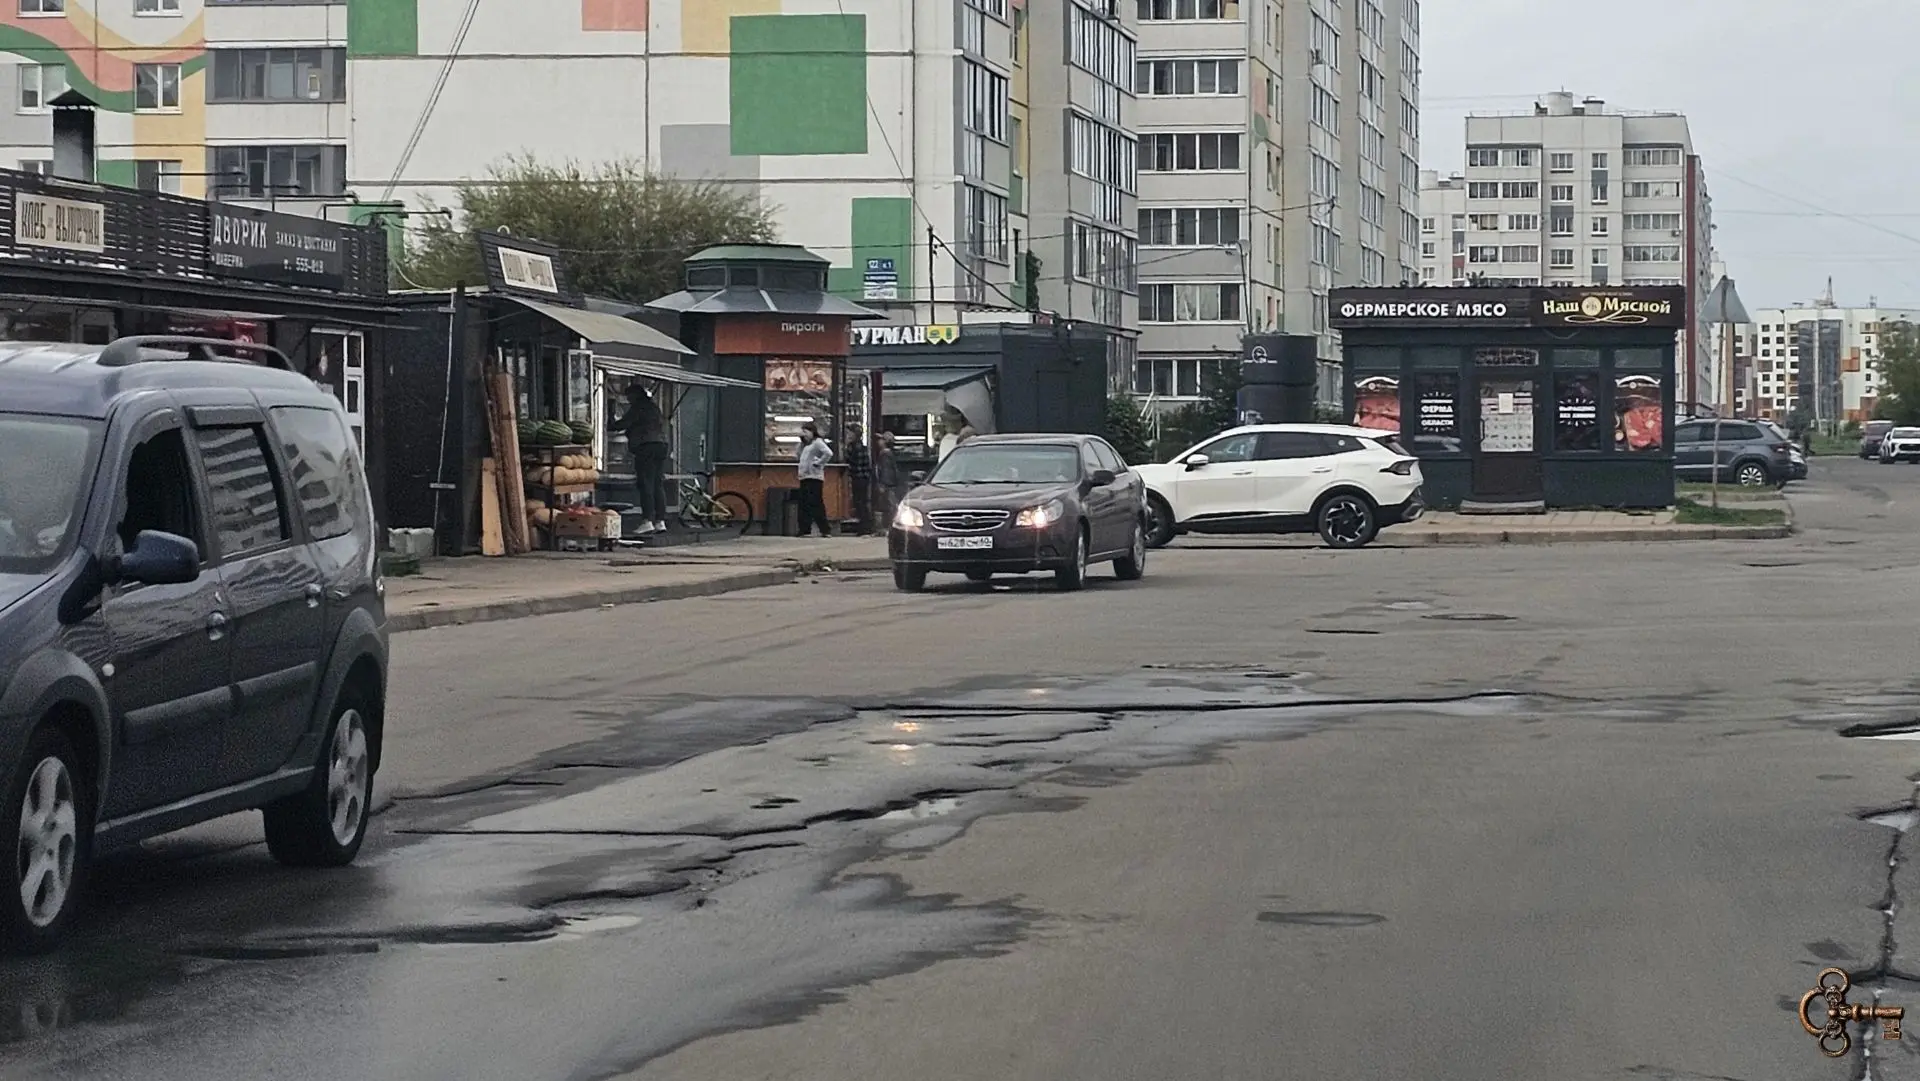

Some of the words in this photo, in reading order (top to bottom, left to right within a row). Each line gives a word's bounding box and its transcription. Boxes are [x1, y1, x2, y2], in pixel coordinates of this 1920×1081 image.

[213, 214, 267, 249] ДВОРИК
[1340, 303, 1449, 317] ФЕРМЕРСКОЕ
[1456, 303, 1507, 317] МЯСО
[1543, 300, 1580, 314] Наш
[1603, 297, 1671, 314] Мясной
[781, 322, 825, 335] пироги
[1421, 405, 1453, 413] ФЕРМА
